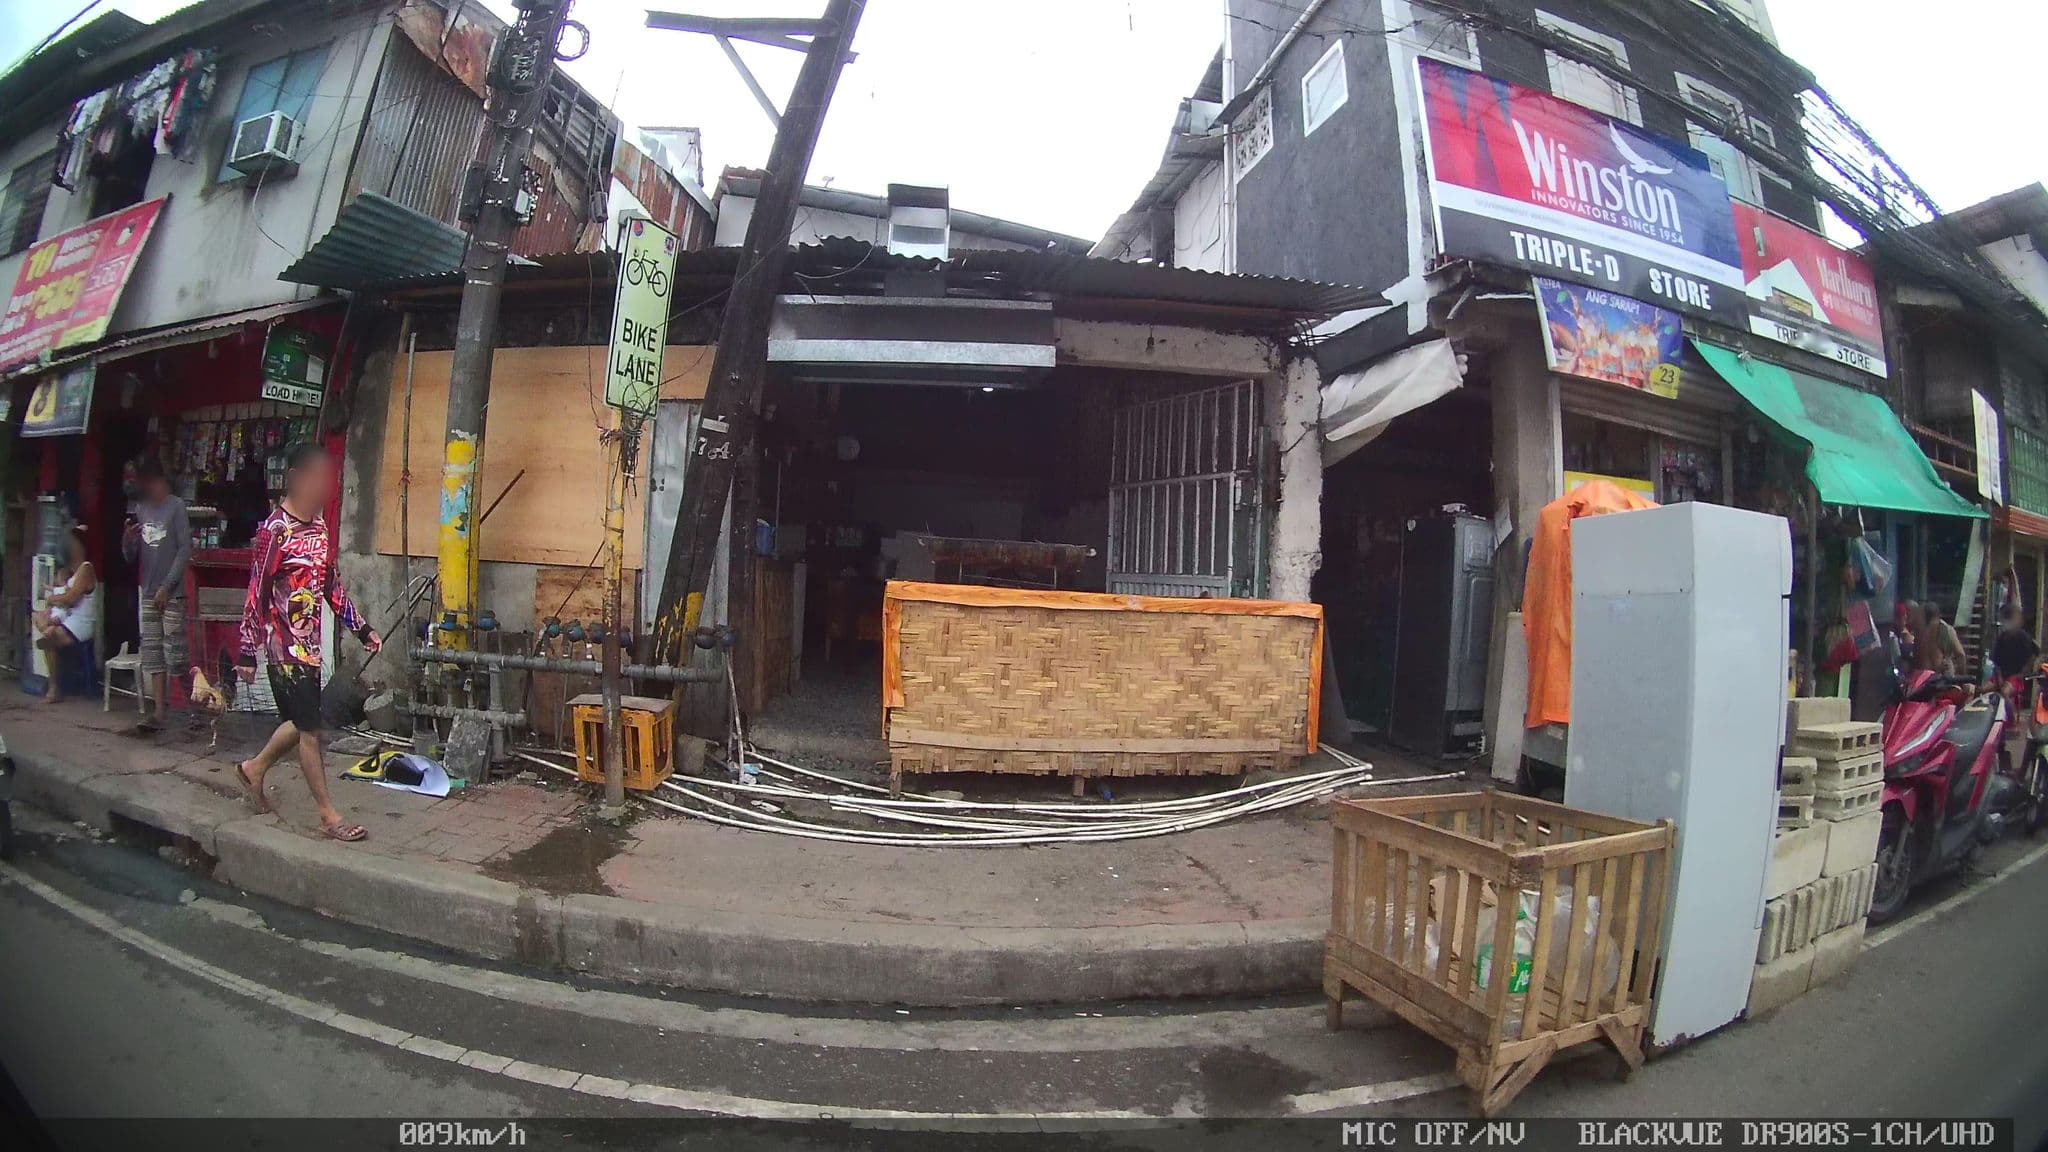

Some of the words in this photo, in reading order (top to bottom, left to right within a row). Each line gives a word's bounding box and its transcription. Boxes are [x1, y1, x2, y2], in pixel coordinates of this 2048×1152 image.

[1511, 119, 1683, 233] Winston
[1531, 189, 1617, 224] INNOVATORS
[1621, 215, 1657, 237] SINCE
[1660, 229, 1685, 246] 1954
[1509, 231, 1620, 282] TRIPLE-D
[1648, 268, 1713, 312] STORE
[1585, 290, 1608, 305] ANG
[622, 318, 657, 353] BIKE
[615, 350, 656, 386] LANE
[1836, 347, 1872, 370] STORE
[265, 384, 290, 400] LOAD
